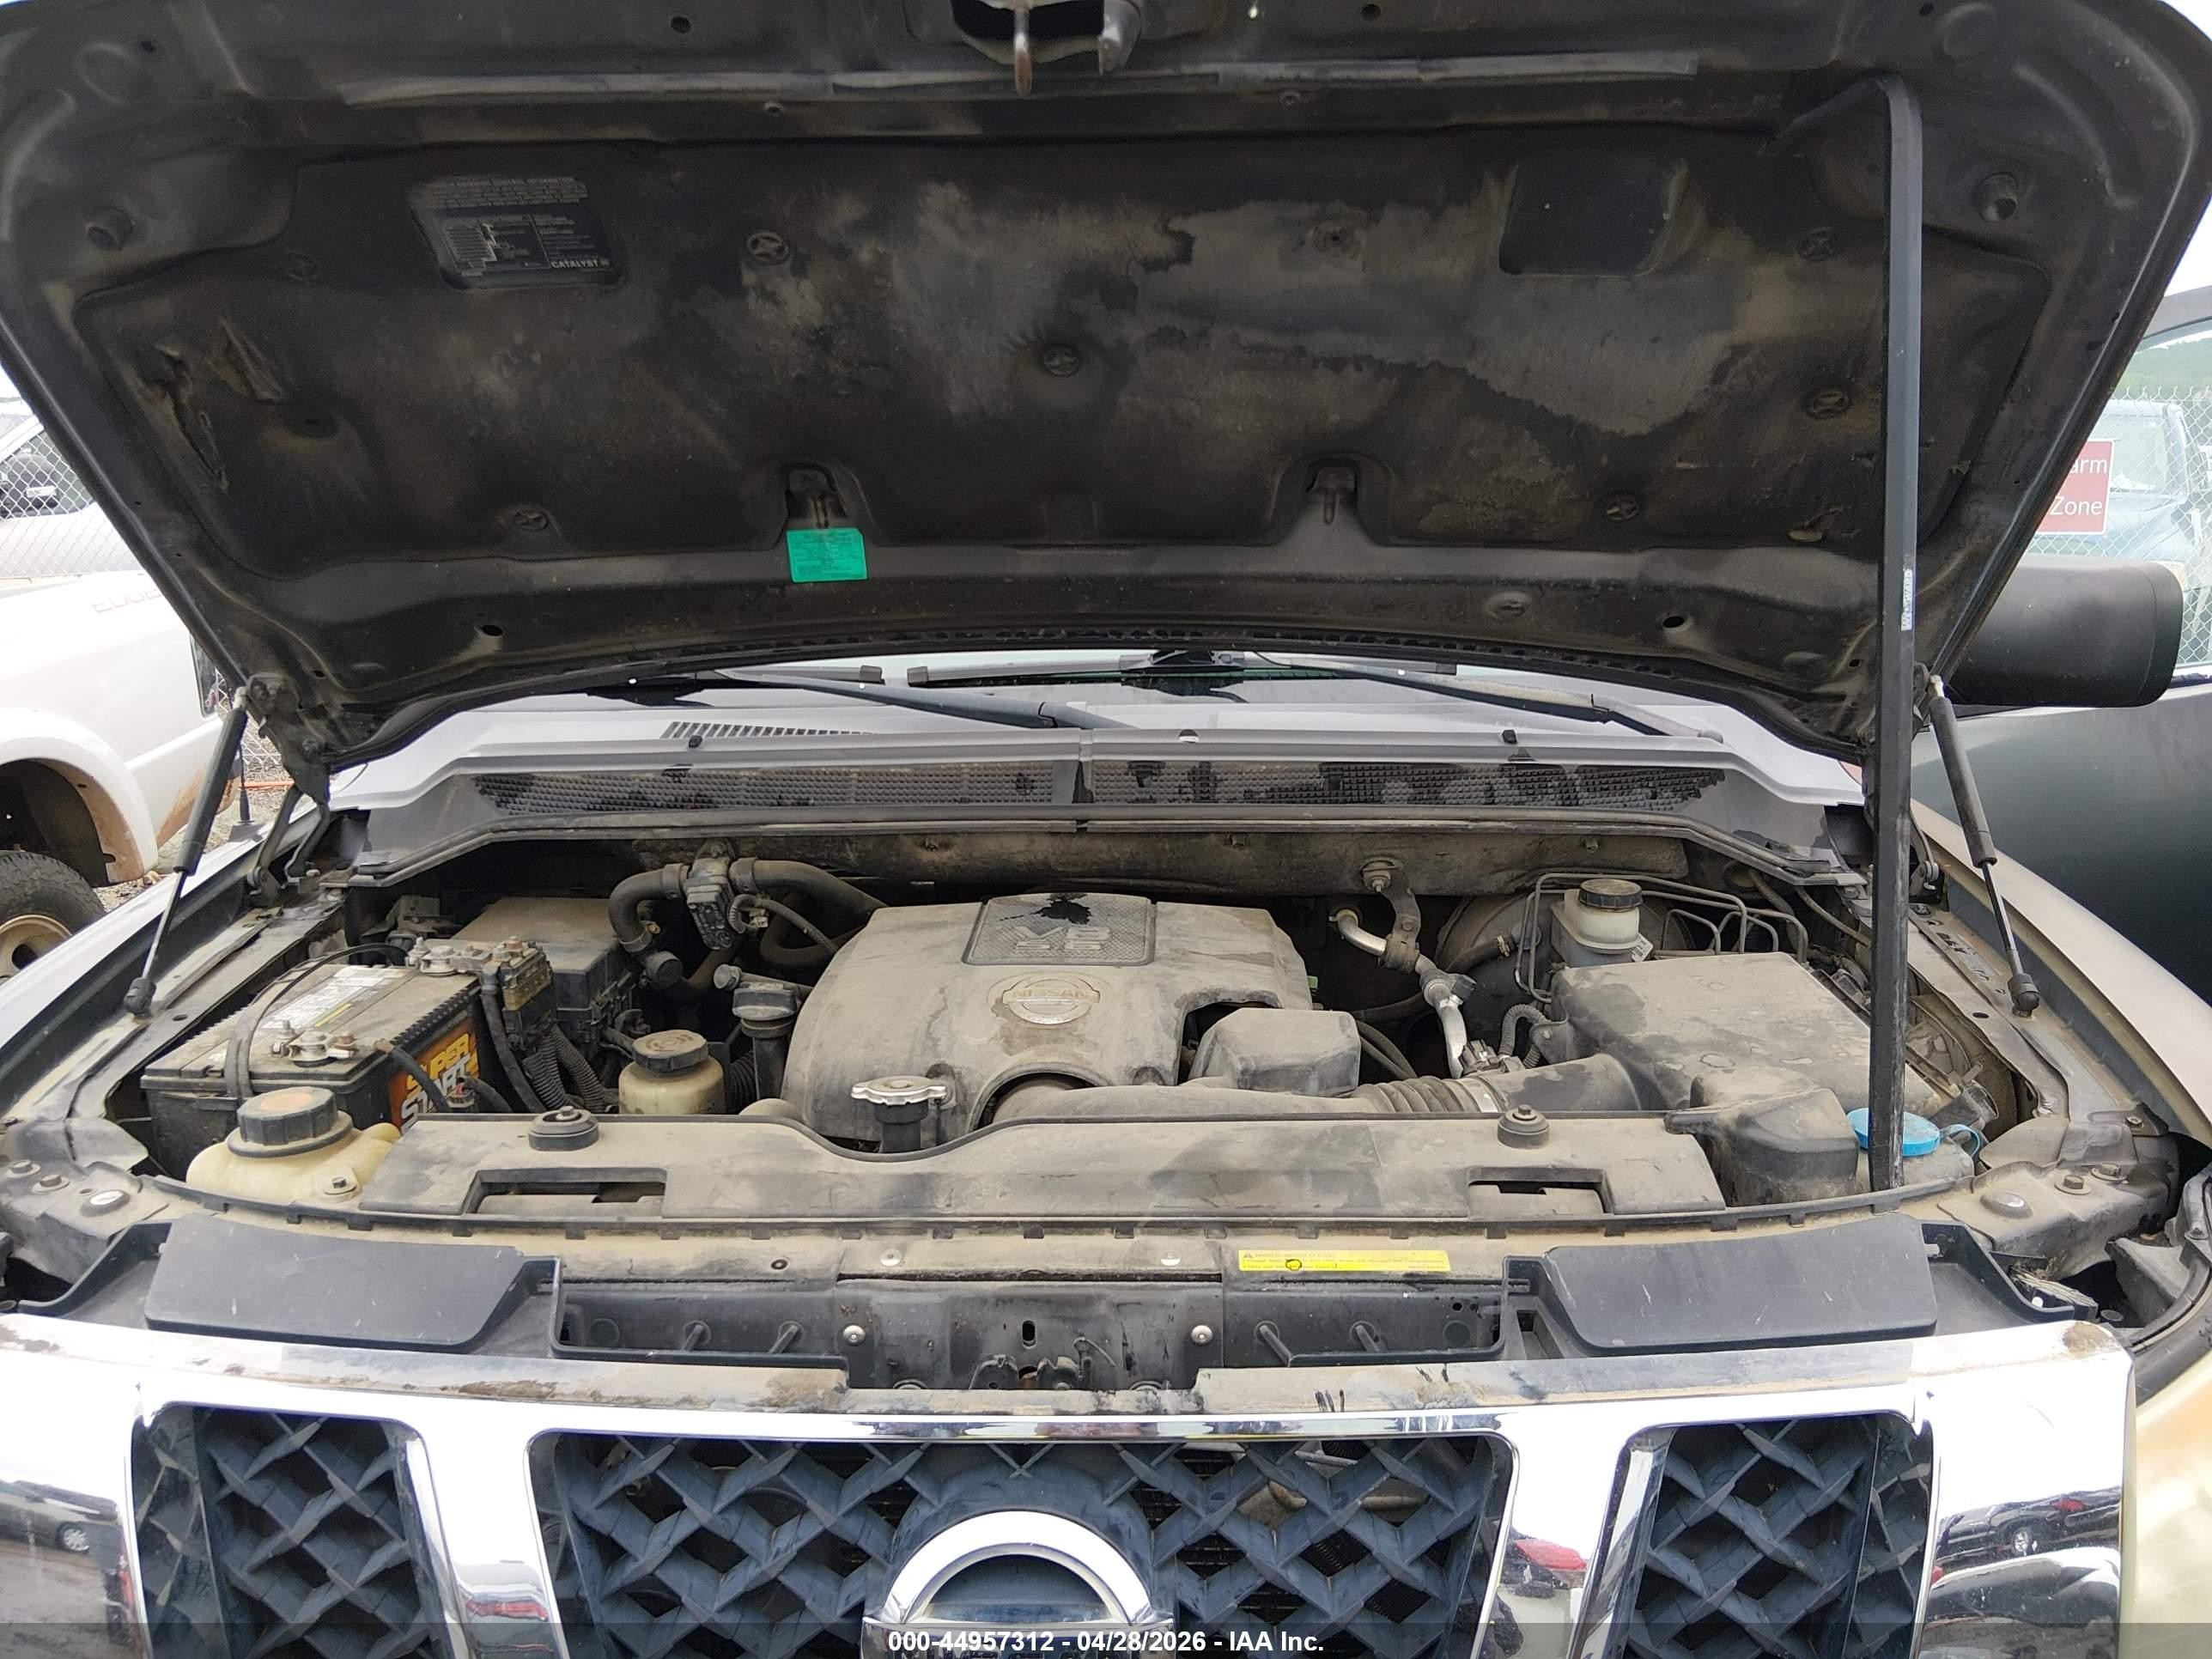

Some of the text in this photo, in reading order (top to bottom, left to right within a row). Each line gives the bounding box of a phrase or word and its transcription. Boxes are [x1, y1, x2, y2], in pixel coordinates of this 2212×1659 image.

[2070, 459, 2108, 474] arm
[2050, 495, 2104, 516] Zone
[1012, 988, 1090, 998] NISSAN
[406, 1032, 471, 1100] SPER
[400, 1052, 471, 1133] STRT
